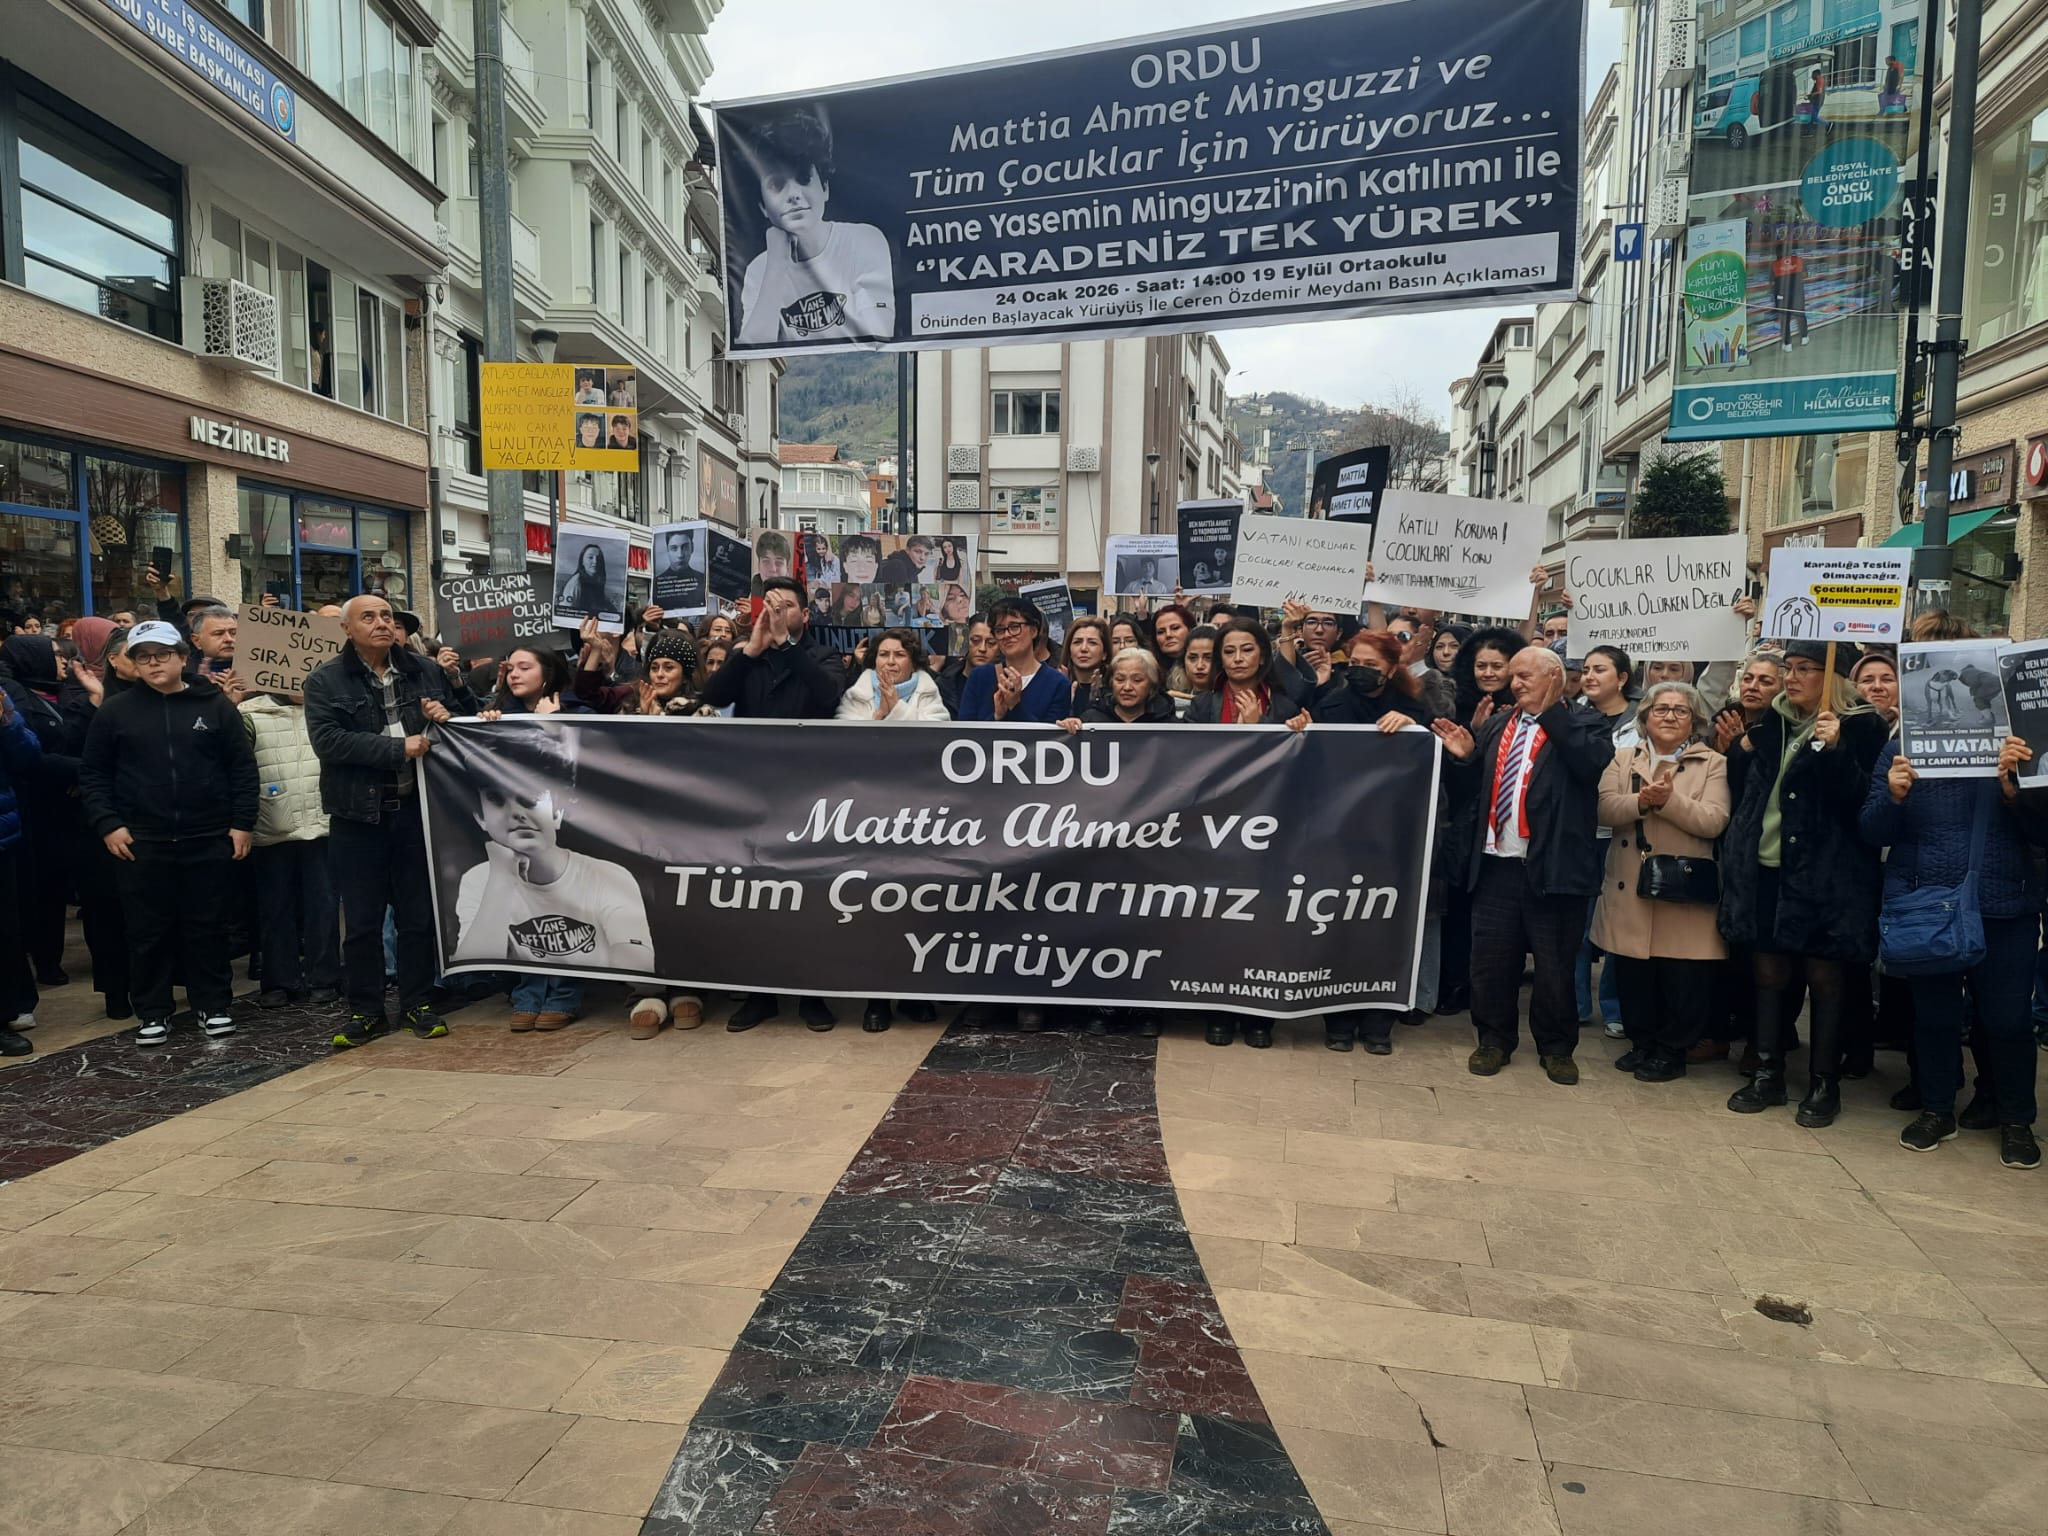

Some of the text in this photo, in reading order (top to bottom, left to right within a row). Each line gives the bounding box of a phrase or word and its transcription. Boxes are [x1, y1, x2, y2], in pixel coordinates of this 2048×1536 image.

[181, 5, 196, 37] İŞ
[199, 25, 265, 89] SENDİKASI
[146, 12, 186, 55] ŞUBE
[189, 44, 265, 115] BAŞKANLIĞI
[1130, 36, 1262, 89] ORDU
[949, 53, 1493, 155] Mattia Ahmet Minguzzi ve
[909, 100, 1553, 199] Tüm Çocuklar İçin Yürüyoruz...
[1807, 167, 1893, 185] BELEDİYECİLİKTE
[1830, 161, 1869, 173] SOSYAL
[906, 214, 982, 248] Anne
[990, 194, 1123, 239] Yasemin
[1359, 155, 1502, 198] Katılımı
[1513, 145, 1561, 179] ile
[1826, 179, 1870, 195] ÖNCÜ
[1822, 190, 1874, 206] OLDUK
[1219, 218, 1319, 256] TEK
[995, 291, 1018, 306] 24
[1022, 286, 1068, 304] Ocak
[1074, 281, 1120, 299] 2026
[1136, 277, 1185, 296] Saat:
[1192, 270, 1246, 288] 14:00
[1251, 267, 1276, 283] 19
[1281, 261, 1332, 281] Eylül
[1338, 251, 1448, 274] Ortaokulu
[799, 292, 826, 314] VANS
[920, 263, 1547, 331] Önünden Başlayacak Yürüyüş İle Ceren Özdemir Meydanı Basın Açıklaması
[803, 309, 826, 329] THE
[1716, 399, 1783, 412] BÜYÜKŞEHİR
[1738, 393, 1762, 401] ORDU
[1727, 408, 1771, 418] BELEDİYESİ
[190, 415, 290, 463] NEZİRLER
[489, 435, 566, 451] UNUTMA
[1340, 467, 1366, 482] MATTİA
[1331, 495, 1372, 512] AHMET İÇİN
[1242, 530, 1358, 551] VATANI KORUMAK
[1297, 561, 1356, 574] KORUMAKLA
[1569, 553, 1732, 589] ÇOCUKLAR UYURKEN
[1803, 561, 1902, 570] Karanlığa Teslim
[439, 573, 532, 600] ÇOCUKLARIN
[1822, 572, 1901, 581] Olmayacağız.
[1813, 585, 1898, 595] Çocuklarımızı
[452, 588, 536, 614] ELLERİNDE
[512, 602, 552, 618] OLUR
[1310, 593, 1360, 612] ATATÜRK
[1819, 596, 1897, 607] Korumalıyız.
[247, 607, 311, 630] SUSMA
[513, 617, 560, 638] DEĞİL
[248, 647, 291, 668] SIRA
[2015, 689, 2041, 702] ANNEM
[1911, 740, 1937, 754] BU
[940, 739, 1120, 786] ORDU
[1927, 756, 1968, 766] CANIYLA
[786, 798, 1279, 851] Mattia Ahmet ve
[664, 866, 1399, 937] Tüm Çocuklarımız için
[532, 917, 568, 934] VANS
[541, 932, 567, 952] THE
[904, 931, 1163, 989] Yürüyor
[1243, 967, 1332, 984] KARADENİZ
[1170, 979, 1397, 1001] YAŞAM HAKKI SAVUNUCULARI
